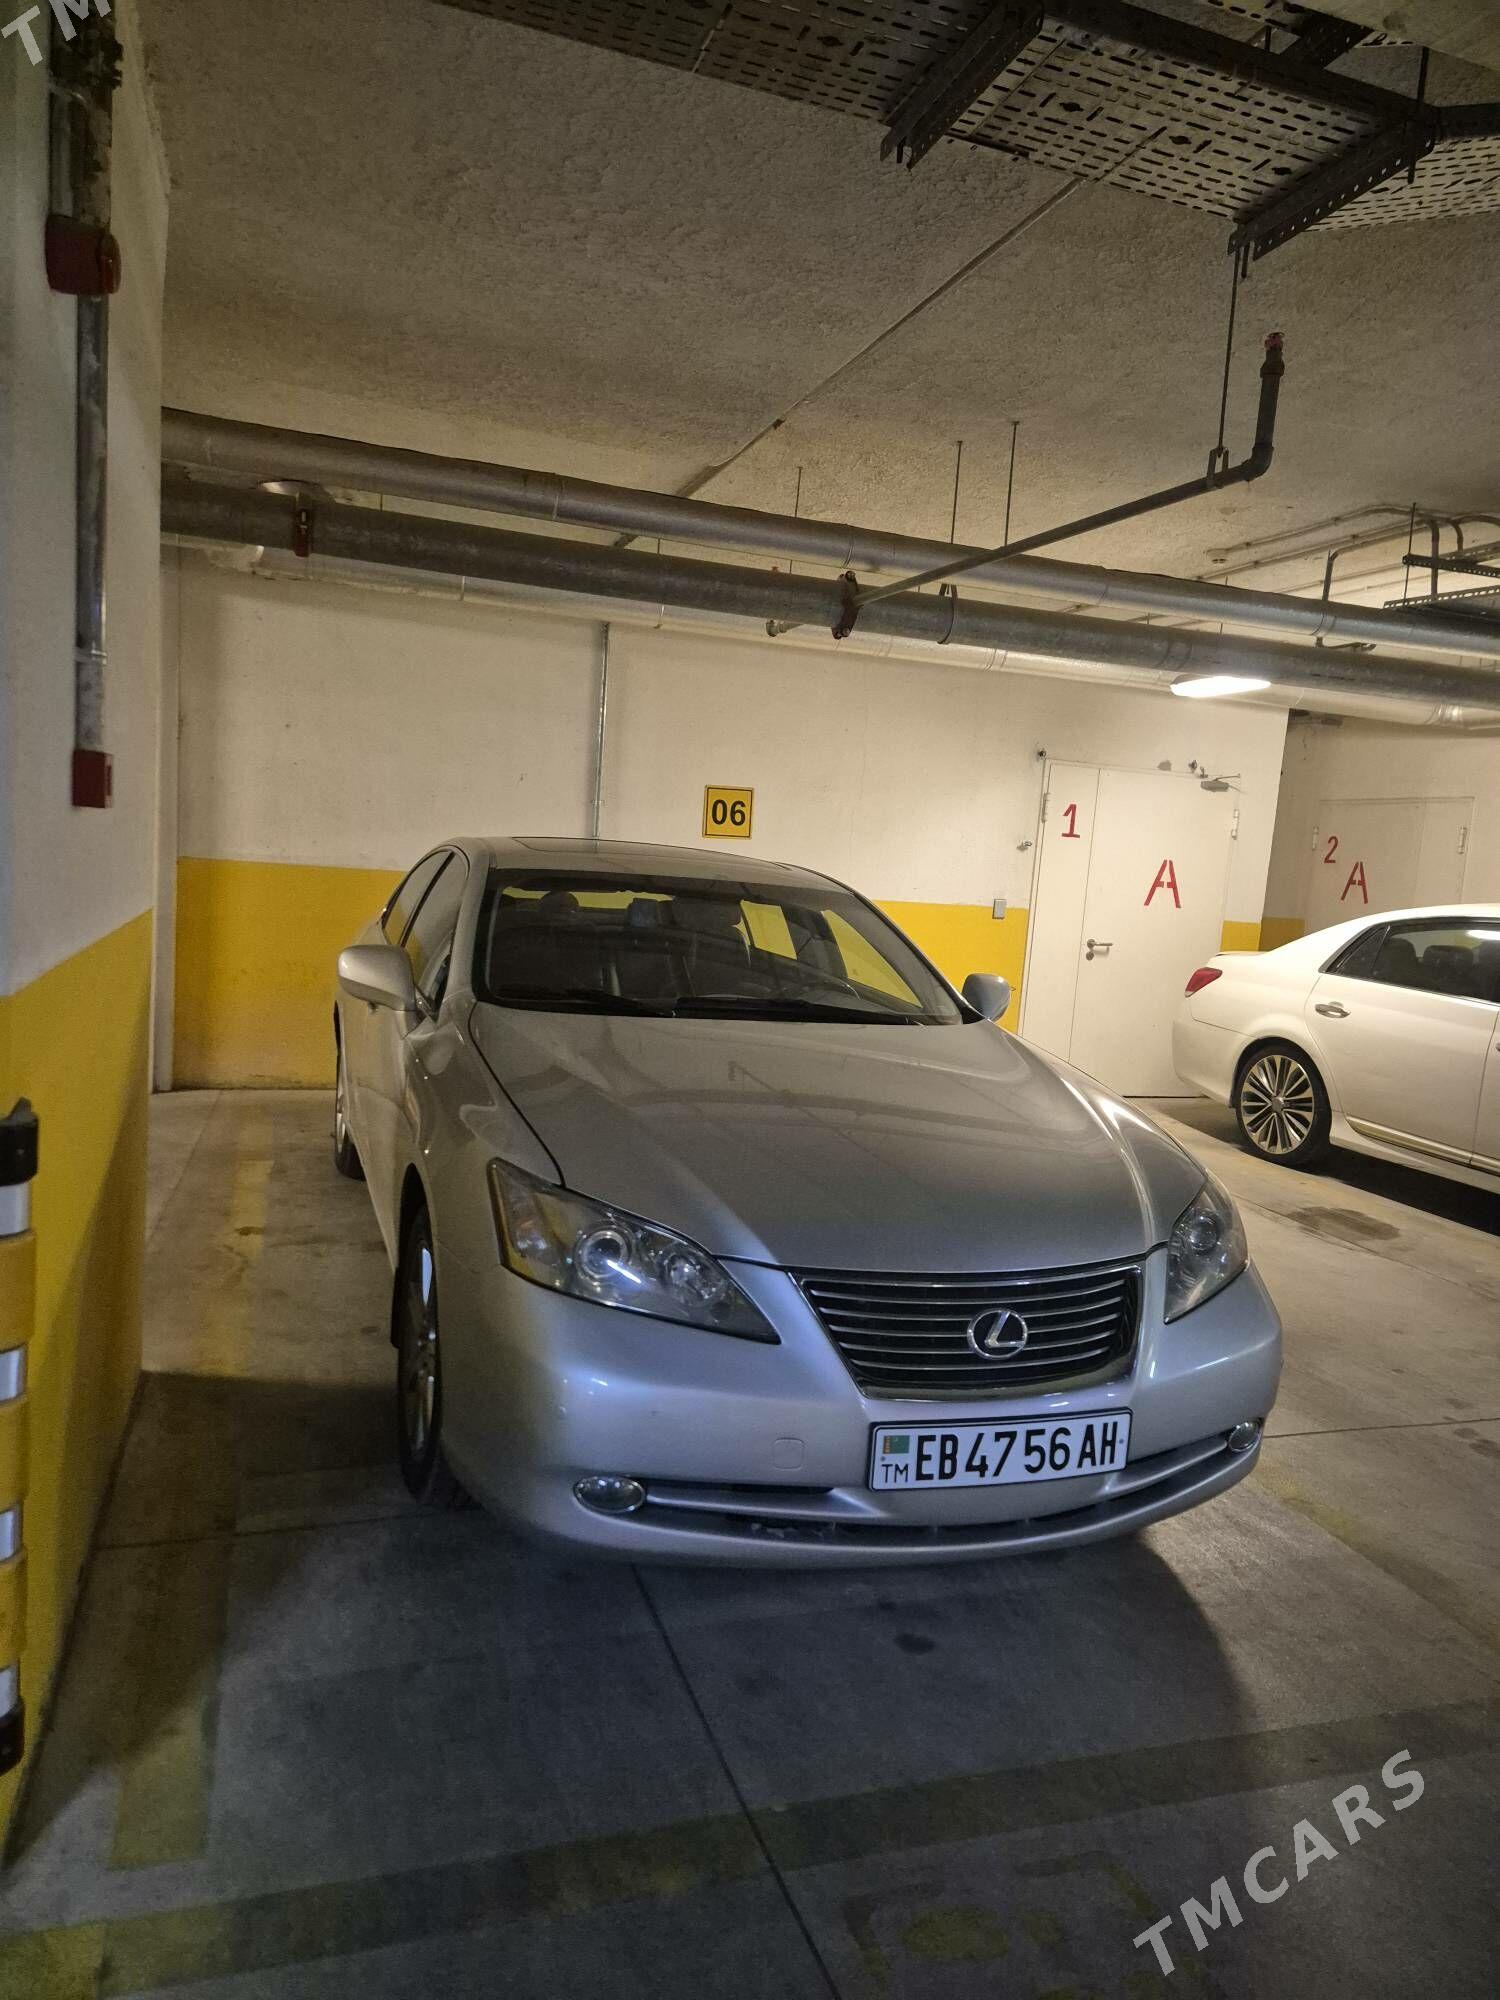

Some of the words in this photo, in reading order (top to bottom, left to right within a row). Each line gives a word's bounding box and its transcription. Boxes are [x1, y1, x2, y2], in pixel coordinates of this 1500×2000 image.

[711, 798, 746, 826] 06
[1061, 803, 1081, 838] 1
[1323, 836, 1339, 864] 2
[1143, 859, 1182, 908] A
[1340, 861, 1369, 904] A
[881, 1463, 909, 1483] TM
